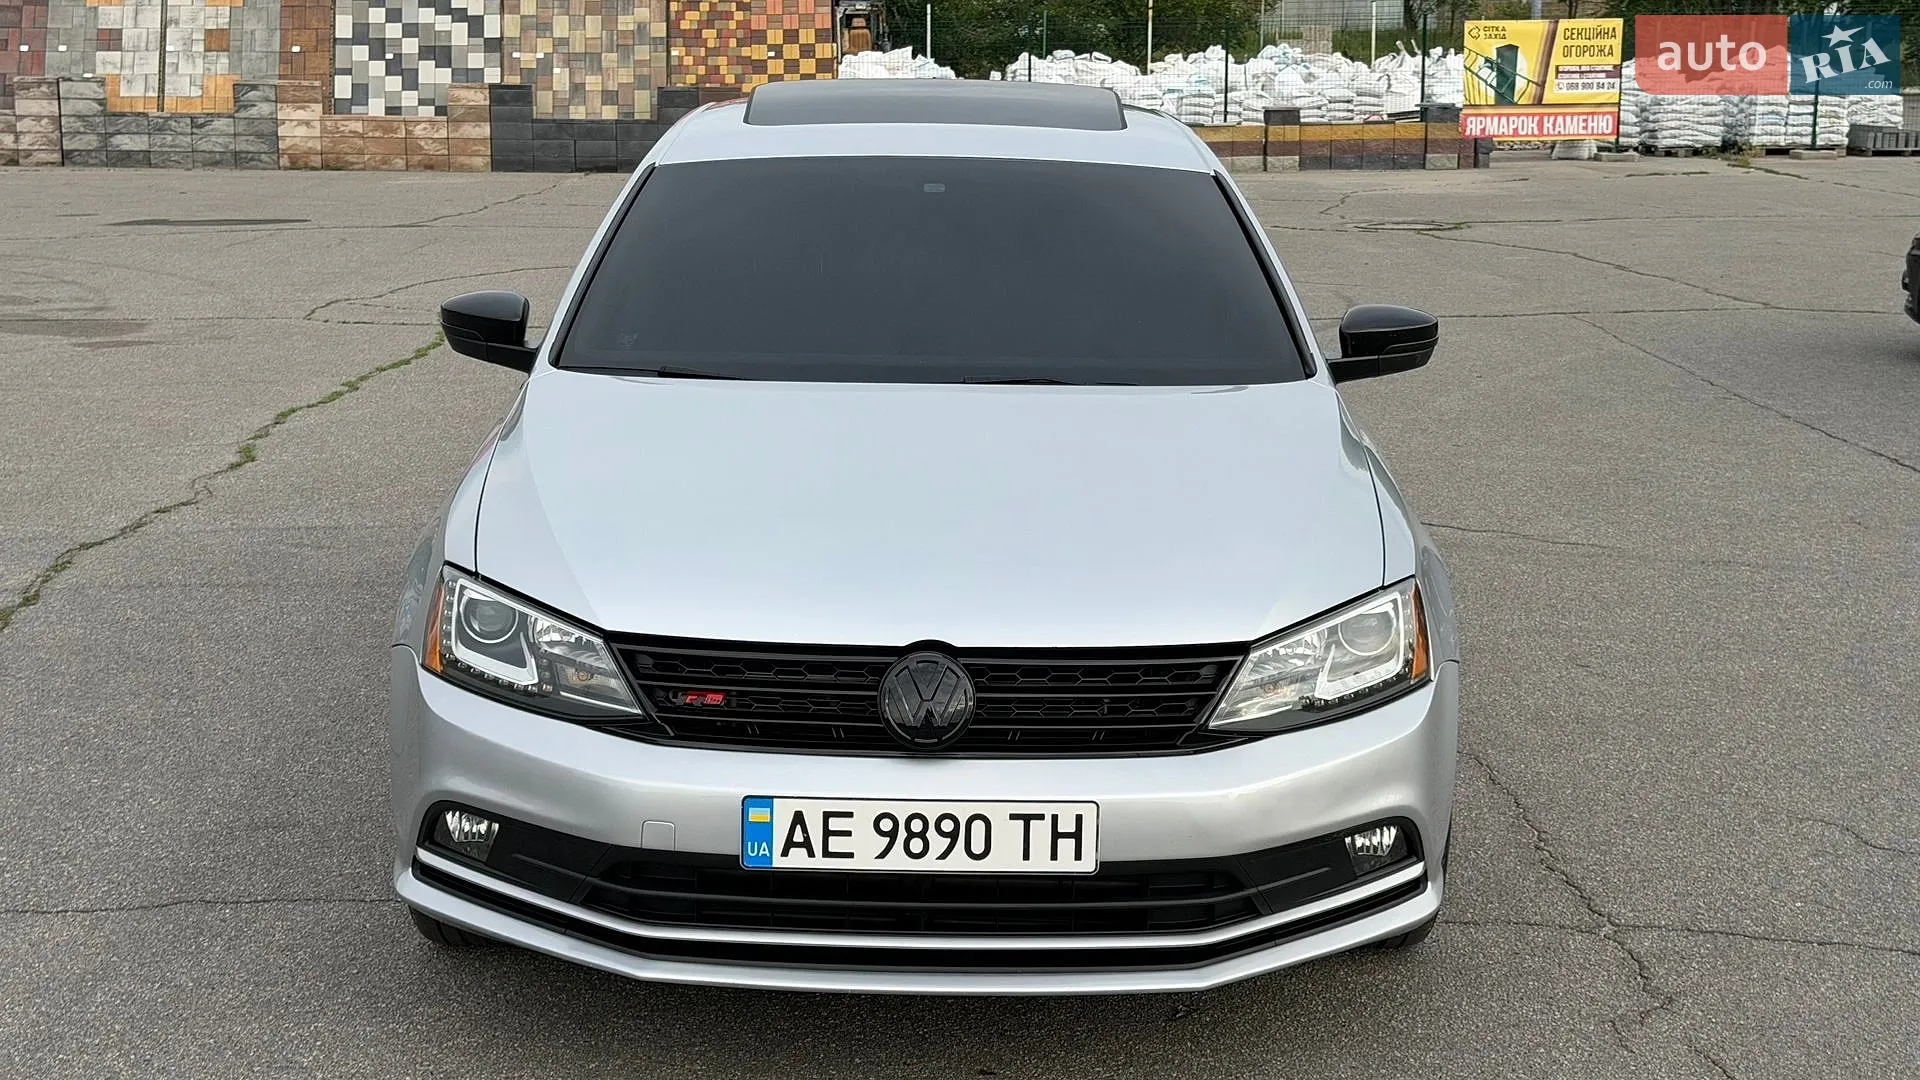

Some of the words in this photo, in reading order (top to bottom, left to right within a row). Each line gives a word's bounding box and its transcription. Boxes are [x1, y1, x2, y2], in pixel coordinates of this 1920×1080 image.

[1563, 25, 1617, 41] СЕКЦІЙНА
[1562, 44, 1614, 58] ОГОРОЖА
[1465, 116, 1539, 136] ЯРМАРОК
[1543, 114, 1612, 135] КАМЕНЮ
[780, 810, 855, 859] AE
[873, 811, 992, 861] 9890
[1009, 813, 1083, 861] TH
[748, 842, 770, 857] UA
